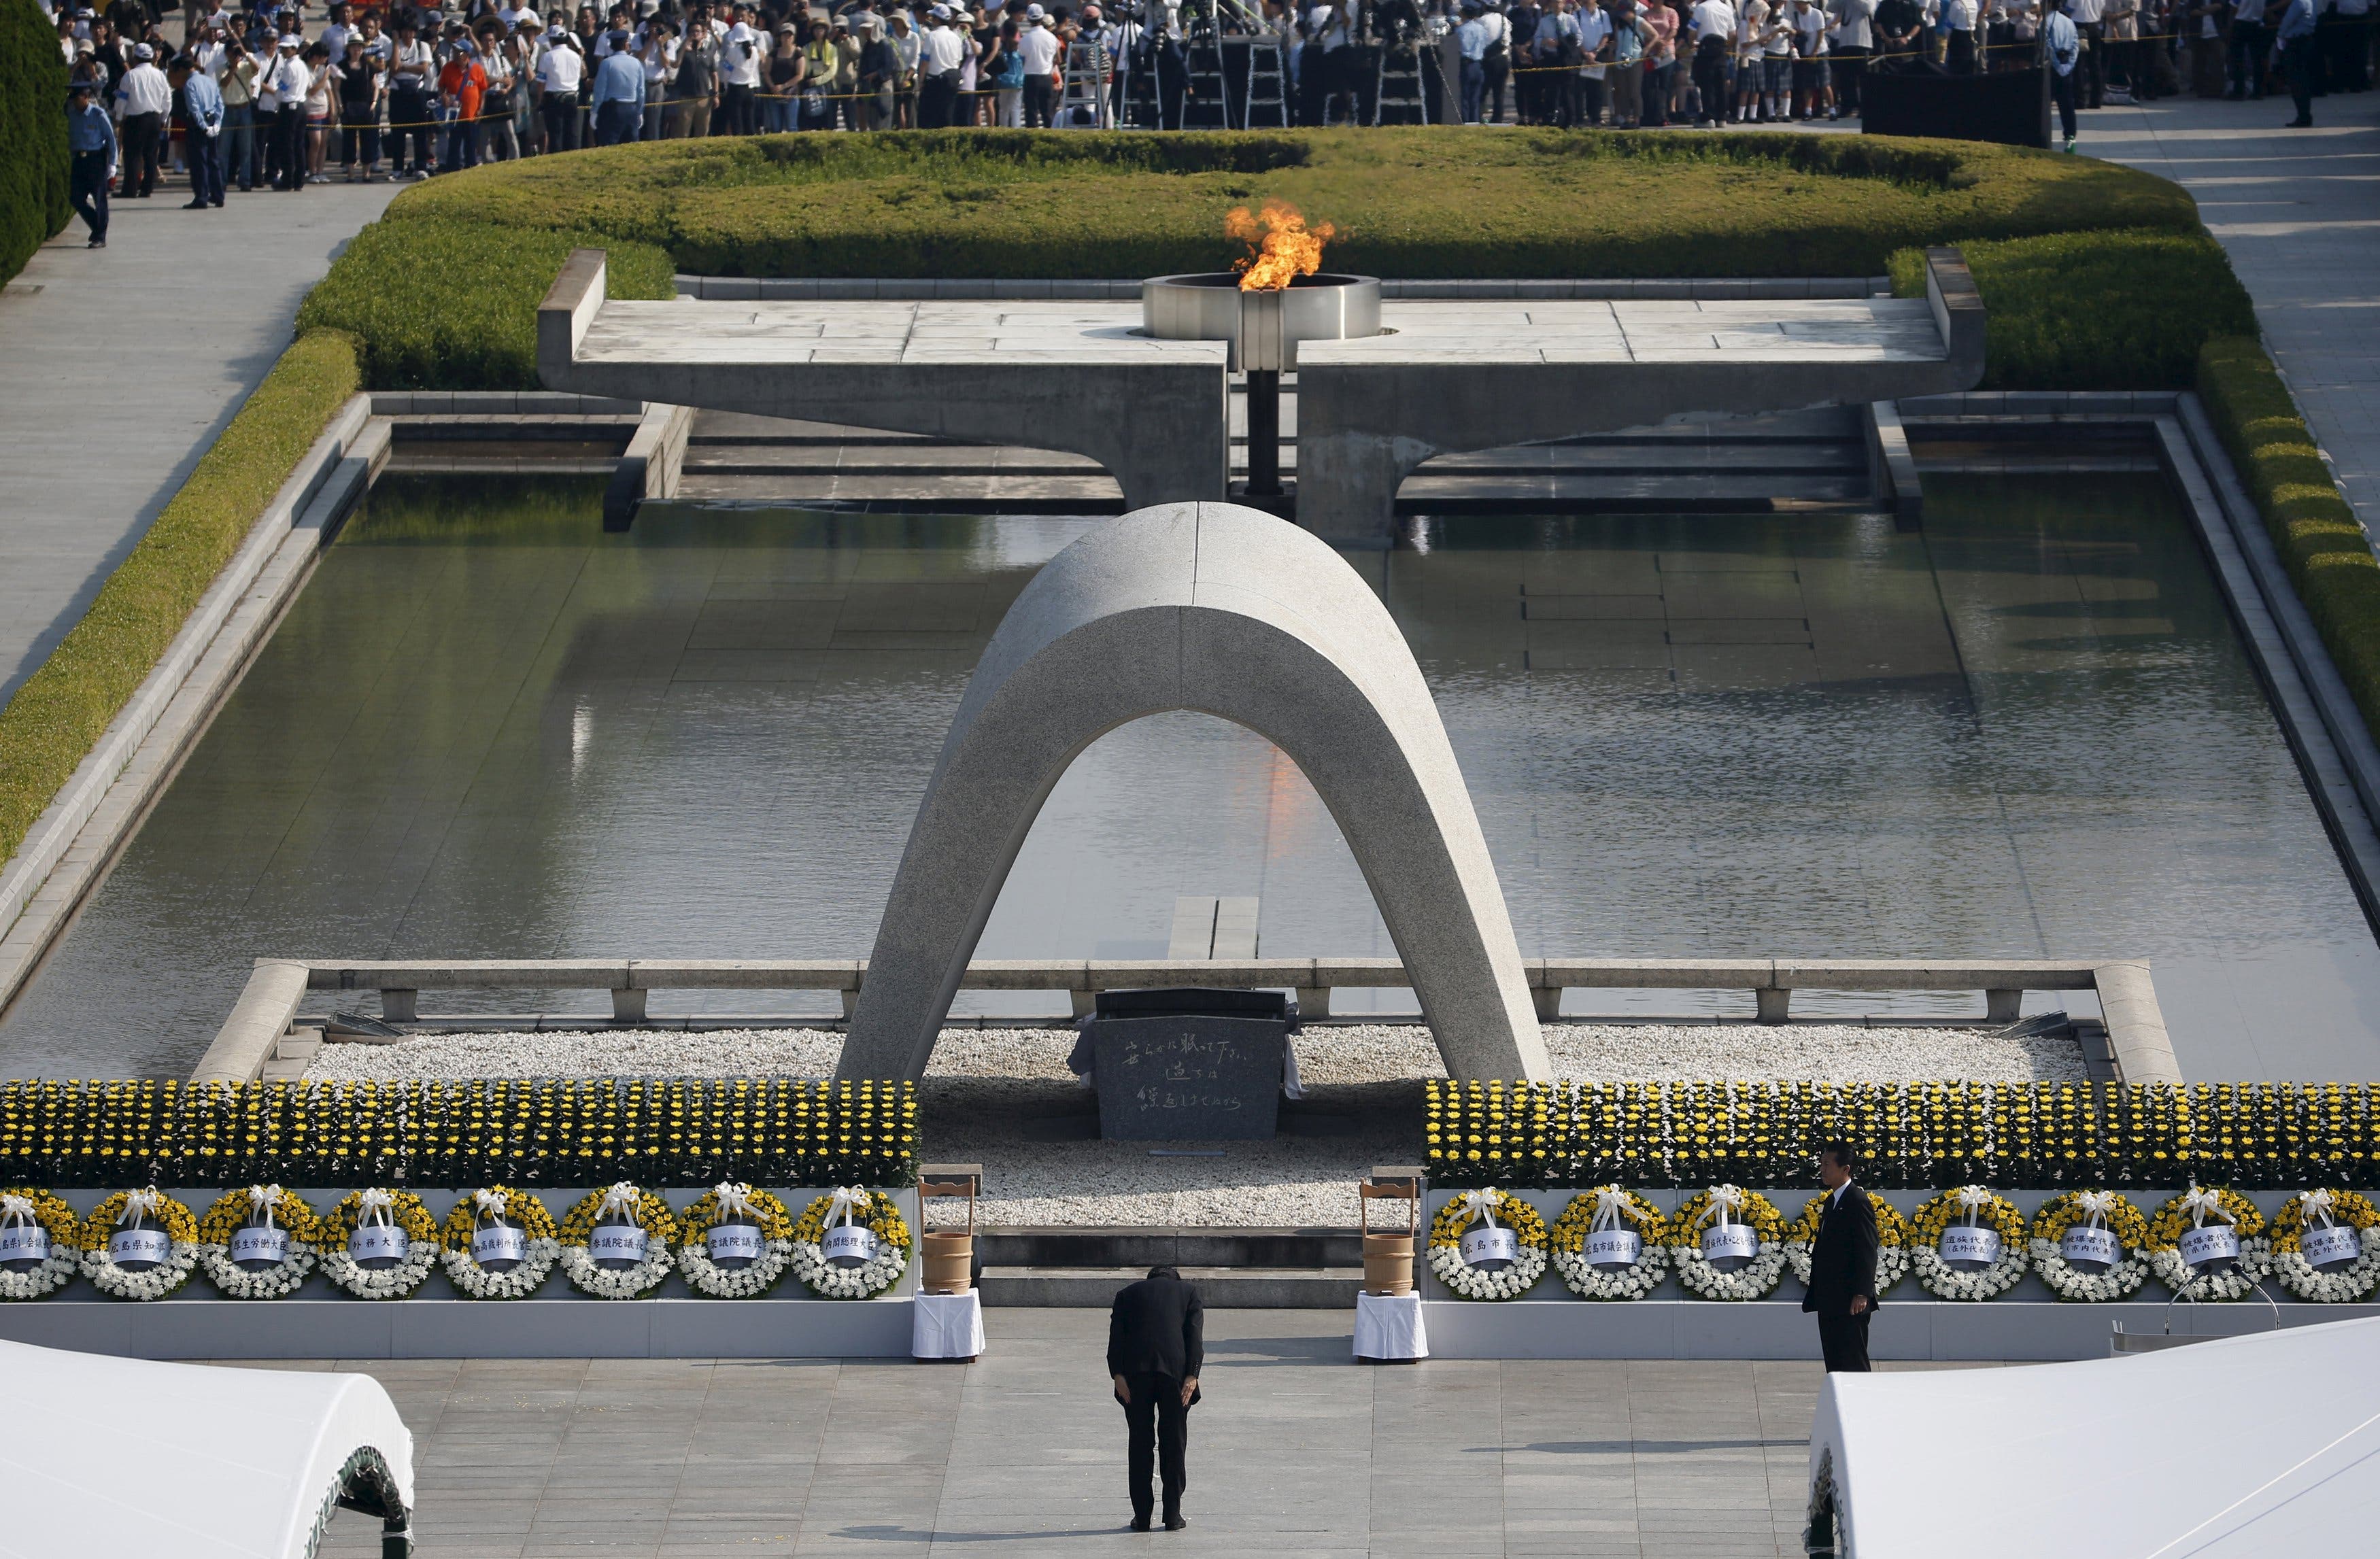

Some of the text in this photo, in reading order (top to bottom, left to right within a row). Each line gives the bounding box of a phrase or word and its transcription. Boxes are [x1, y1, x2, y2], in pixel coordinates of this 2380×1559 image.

[111, 1240, 166, 1253] 広島県知事
[233, 1237, 287, 1251] 厚生労働大臣
[353, 1237, 405, 1250] 外務大臣
[593, 1237, 644, 1250] 参議院議長
[709, 1237, 762, 1248] 衆議院議長
[826, 1237, 874, 1252] 内閣総理大臣
[1465, 1238, 1514, 1254] 広島市長
[1586, 1240, 1637, 1255] 広島市議会議長
[1945, 1235, 1992, 1246] 遺族代表
[2067, 1235, 2117, 1249] 被爆者代表
[2303, 1234, 2357, 1249] 被爆者代表
